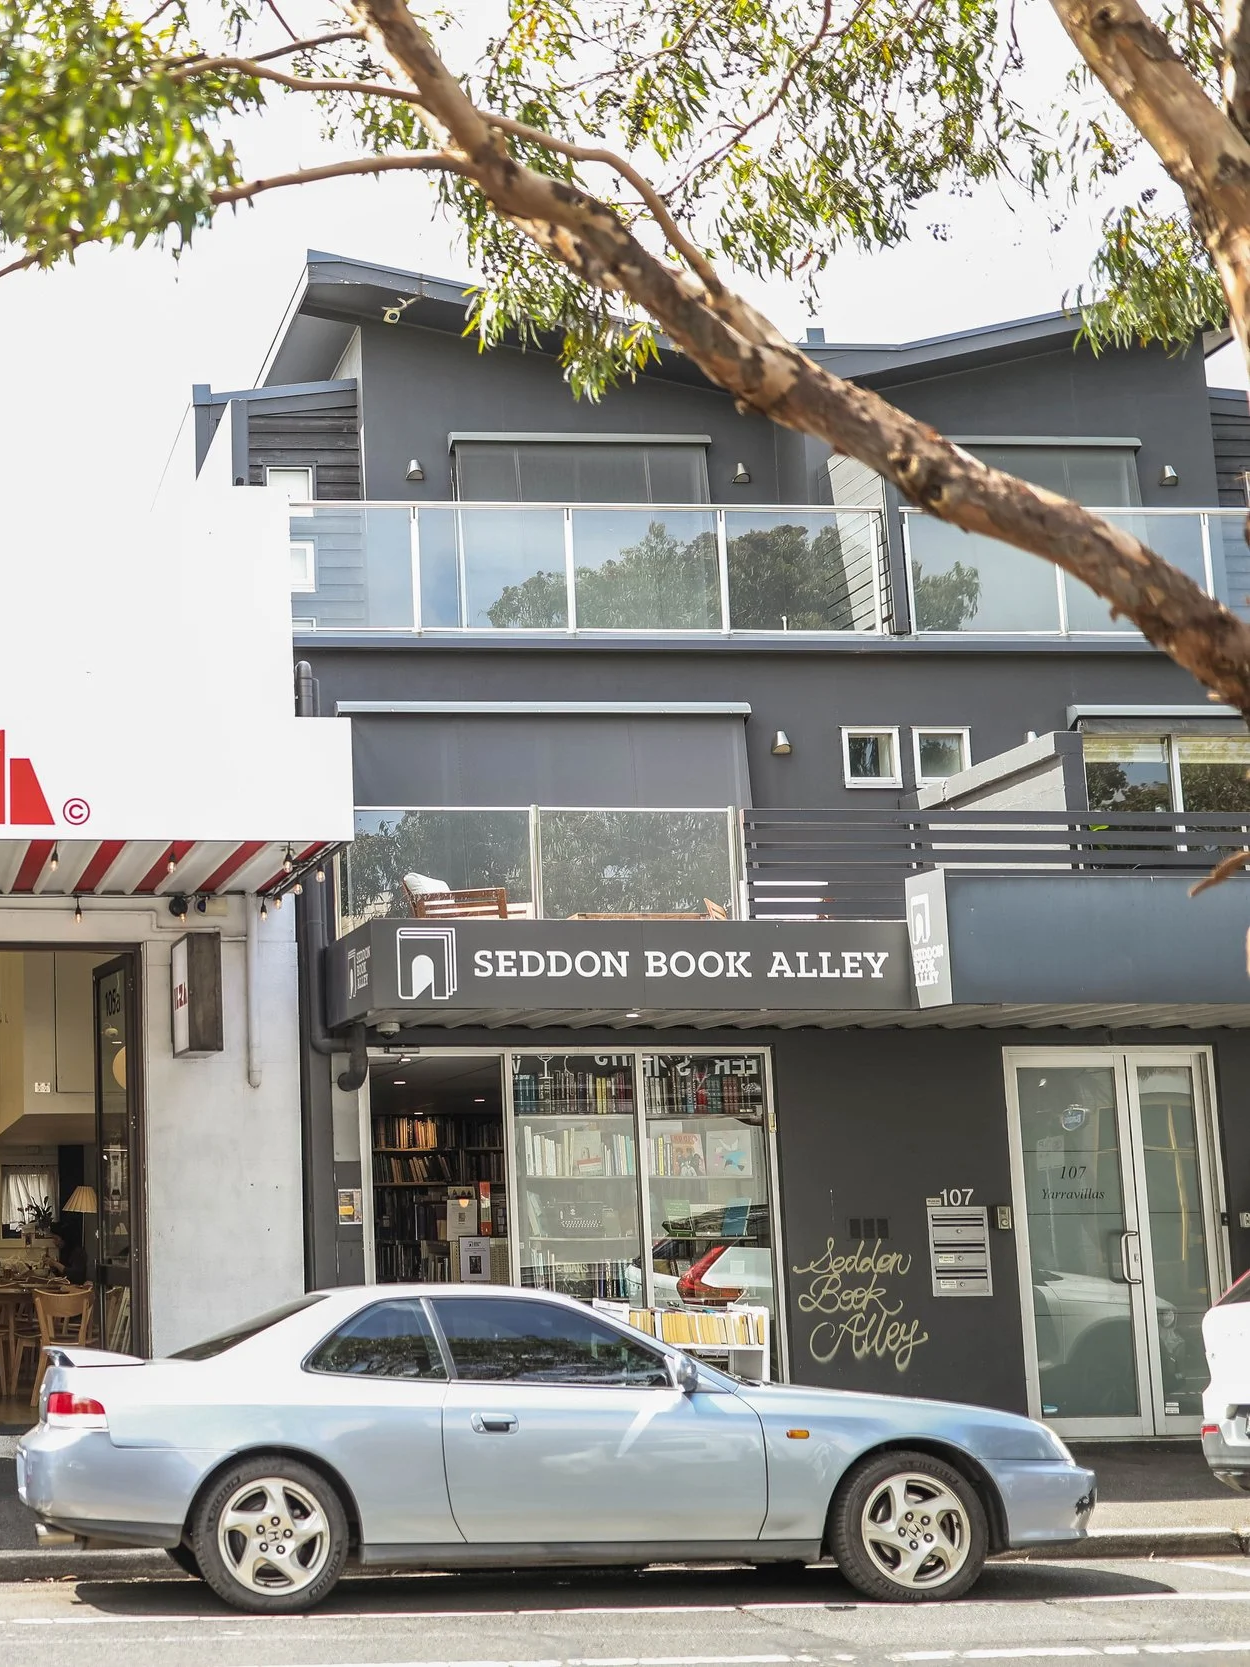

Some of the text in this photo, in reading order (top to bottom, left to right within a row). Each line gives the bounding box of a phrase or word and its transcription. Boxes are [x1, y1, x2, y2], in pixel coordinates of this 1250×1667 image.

[473, 949, 890, 979] SEDDON BOOK ALLEY
[1060, 1165, 1087, 1179] 107
[939, 1188, 974, 1206] 107
[1042, 1188, 1105, 1200] Yarravillas
[798, 1272, 904, 1315] Book
[810, 1311, 929, 1373] Alley
